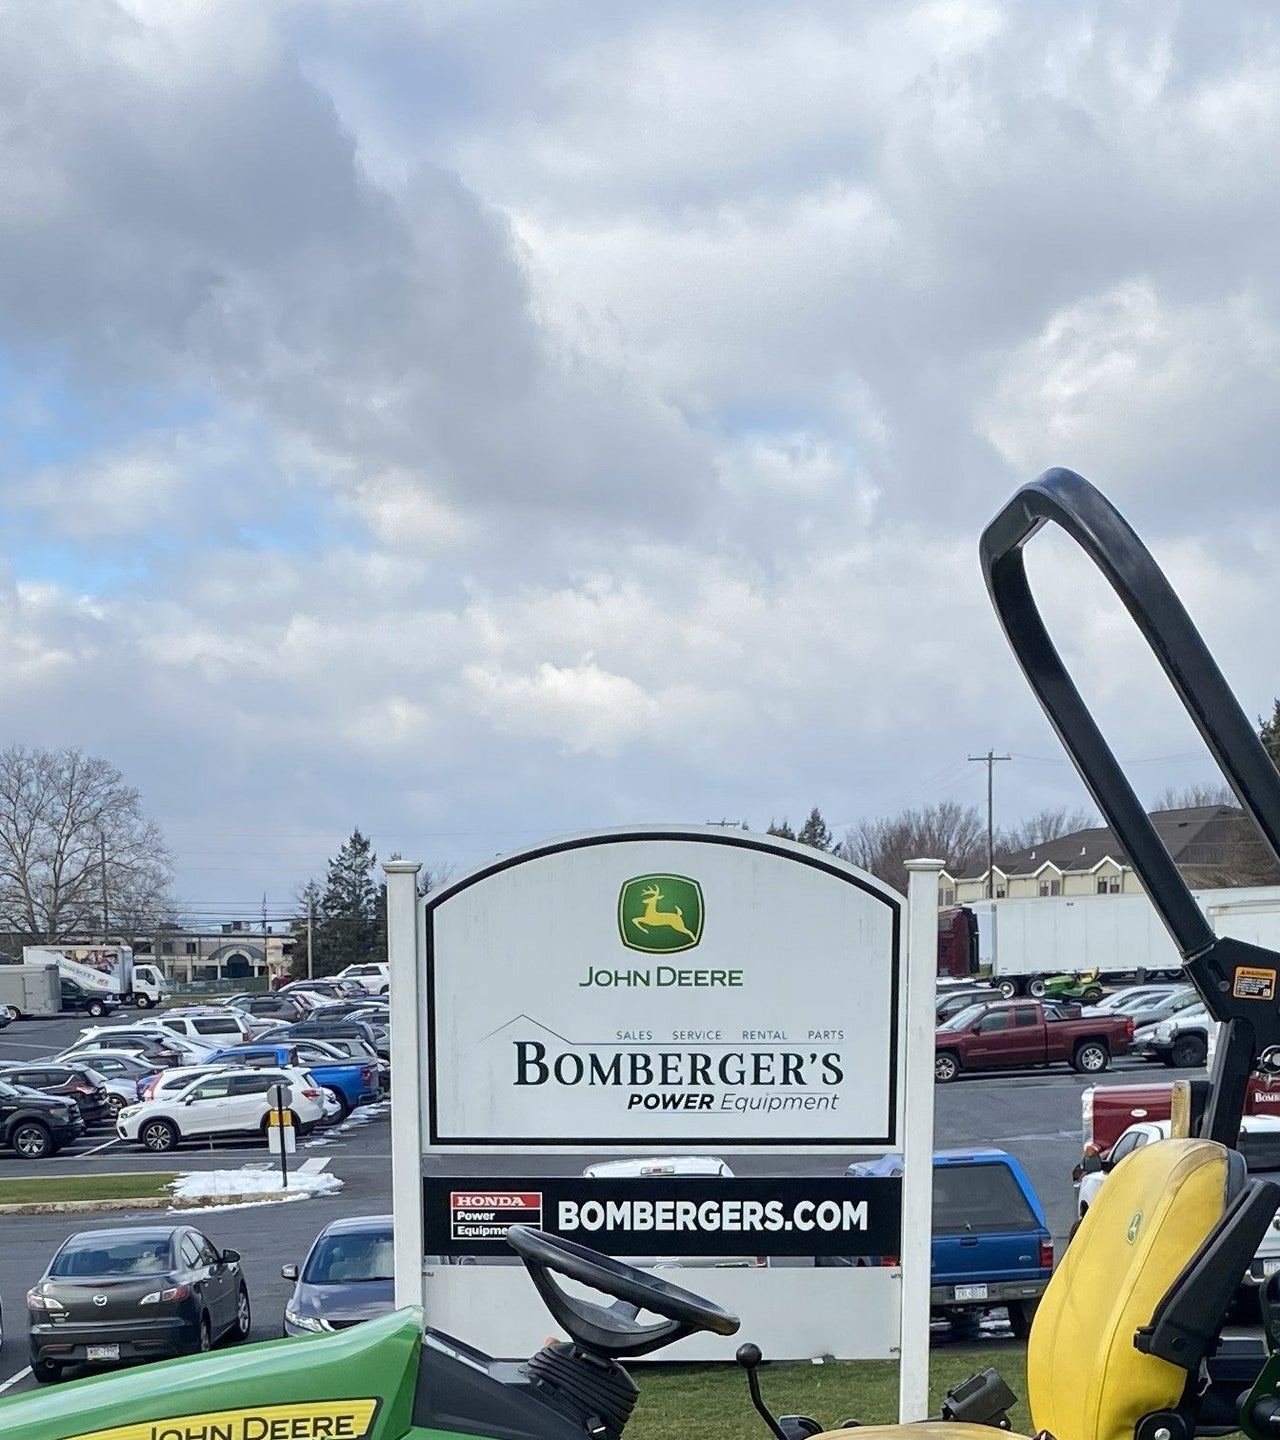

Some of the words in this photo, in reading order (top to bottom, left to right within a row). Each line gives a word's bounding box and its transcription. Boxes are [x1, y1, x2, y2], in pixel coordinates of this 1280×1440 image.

[579, 966, 651, 987] JOHN
[656, 967, 743, 987] DEERE
[616, 1030, 653, 1040] SALES
[672, 1030, 722, 1040] SERVICE
[742, 1030, 788, 1040] RENTAL
[808, 1030, 845, 1040] PARTS
[513, 1041, 844, 1086] BOMBERGER'S
[627, 1093, 715, 1110] POWER
[721, 1092, 840, 1113] Equipment
[457, 1196, 526, 1207] HONDA
[457, 1211, 496, 1221] Power
[558, 1200, 868, 1231] BOMBERGERS.COM
[457, 1226, 508, 1237] Equipme
